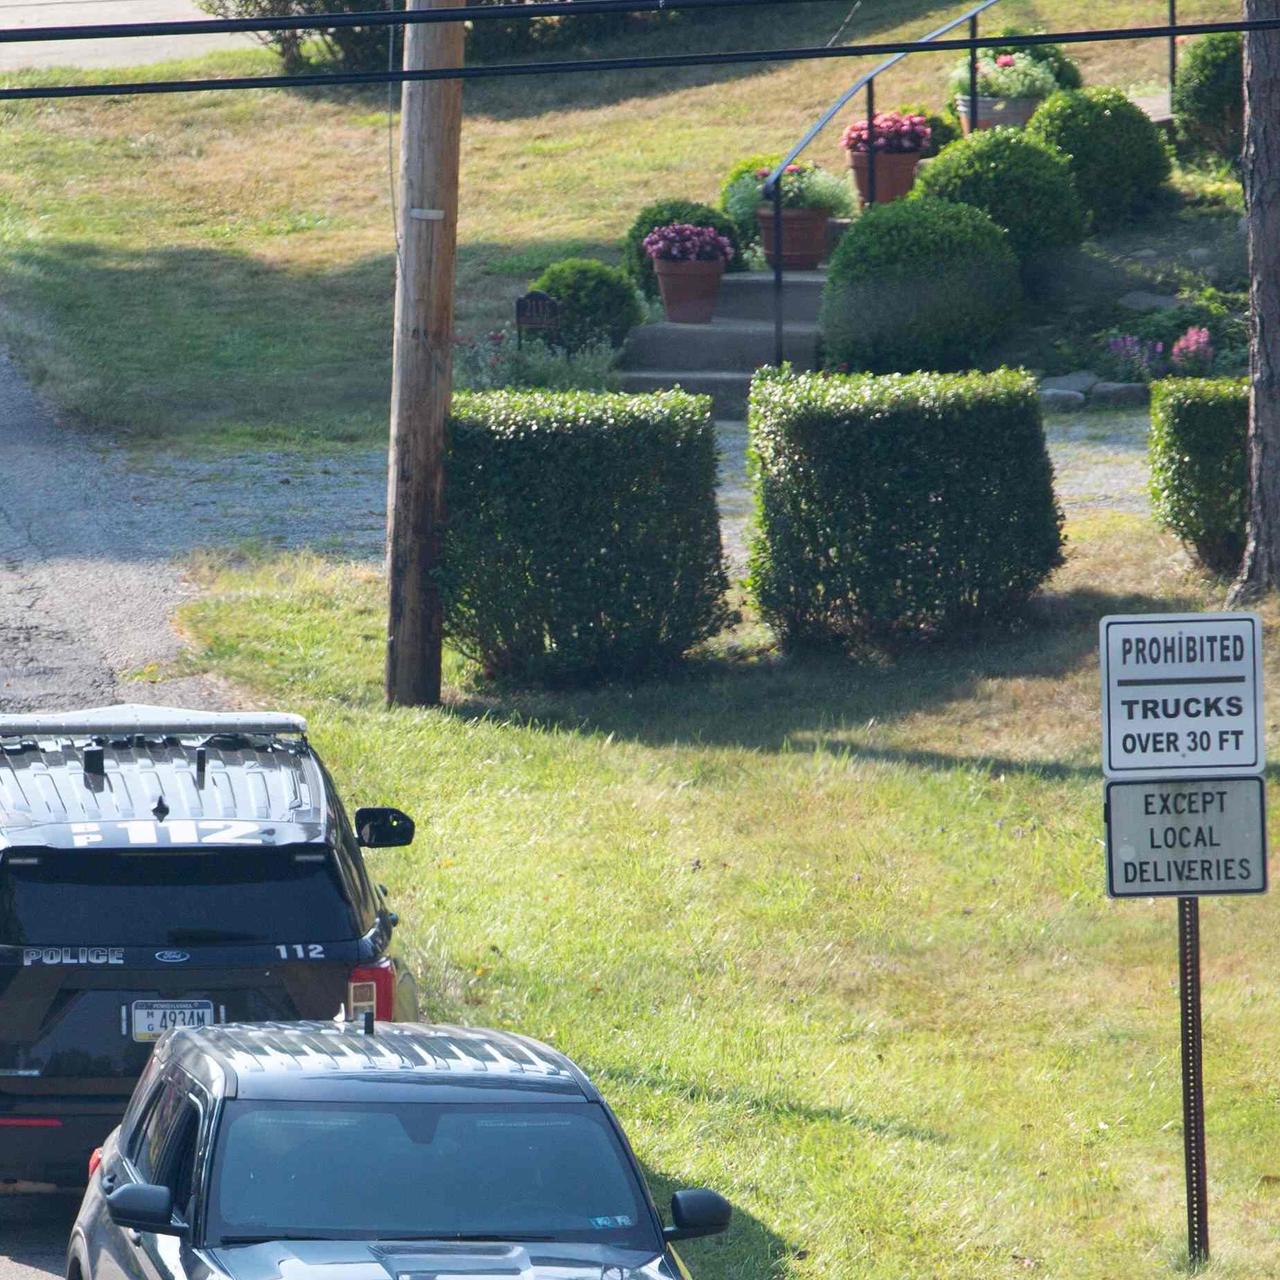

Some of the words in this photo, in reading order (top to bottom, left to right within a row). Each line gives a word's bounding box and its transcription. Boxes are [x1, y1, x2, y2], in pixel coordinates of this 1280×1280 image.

[1122, 635, 1244, 665] PROHIBITED
[1121, 696, 1243, 720] TRUCKS
[1122, 732, 1179, 754] OVER
[1186, 731, 1211, 752] 30
[1219, 730, 1244, 751] FT
[1144, 791, 1228, 815] EXCEPT
[116, 819, 264, 844] 112
[1150, 826, 1220, 849] LOCAL
[1124, 858, 1251, 883] DELIVERIES
[23, 947, 124, 966] POLICE
[275, 944, 325, 959] 112
[147, 1024, 154, 1032] G
